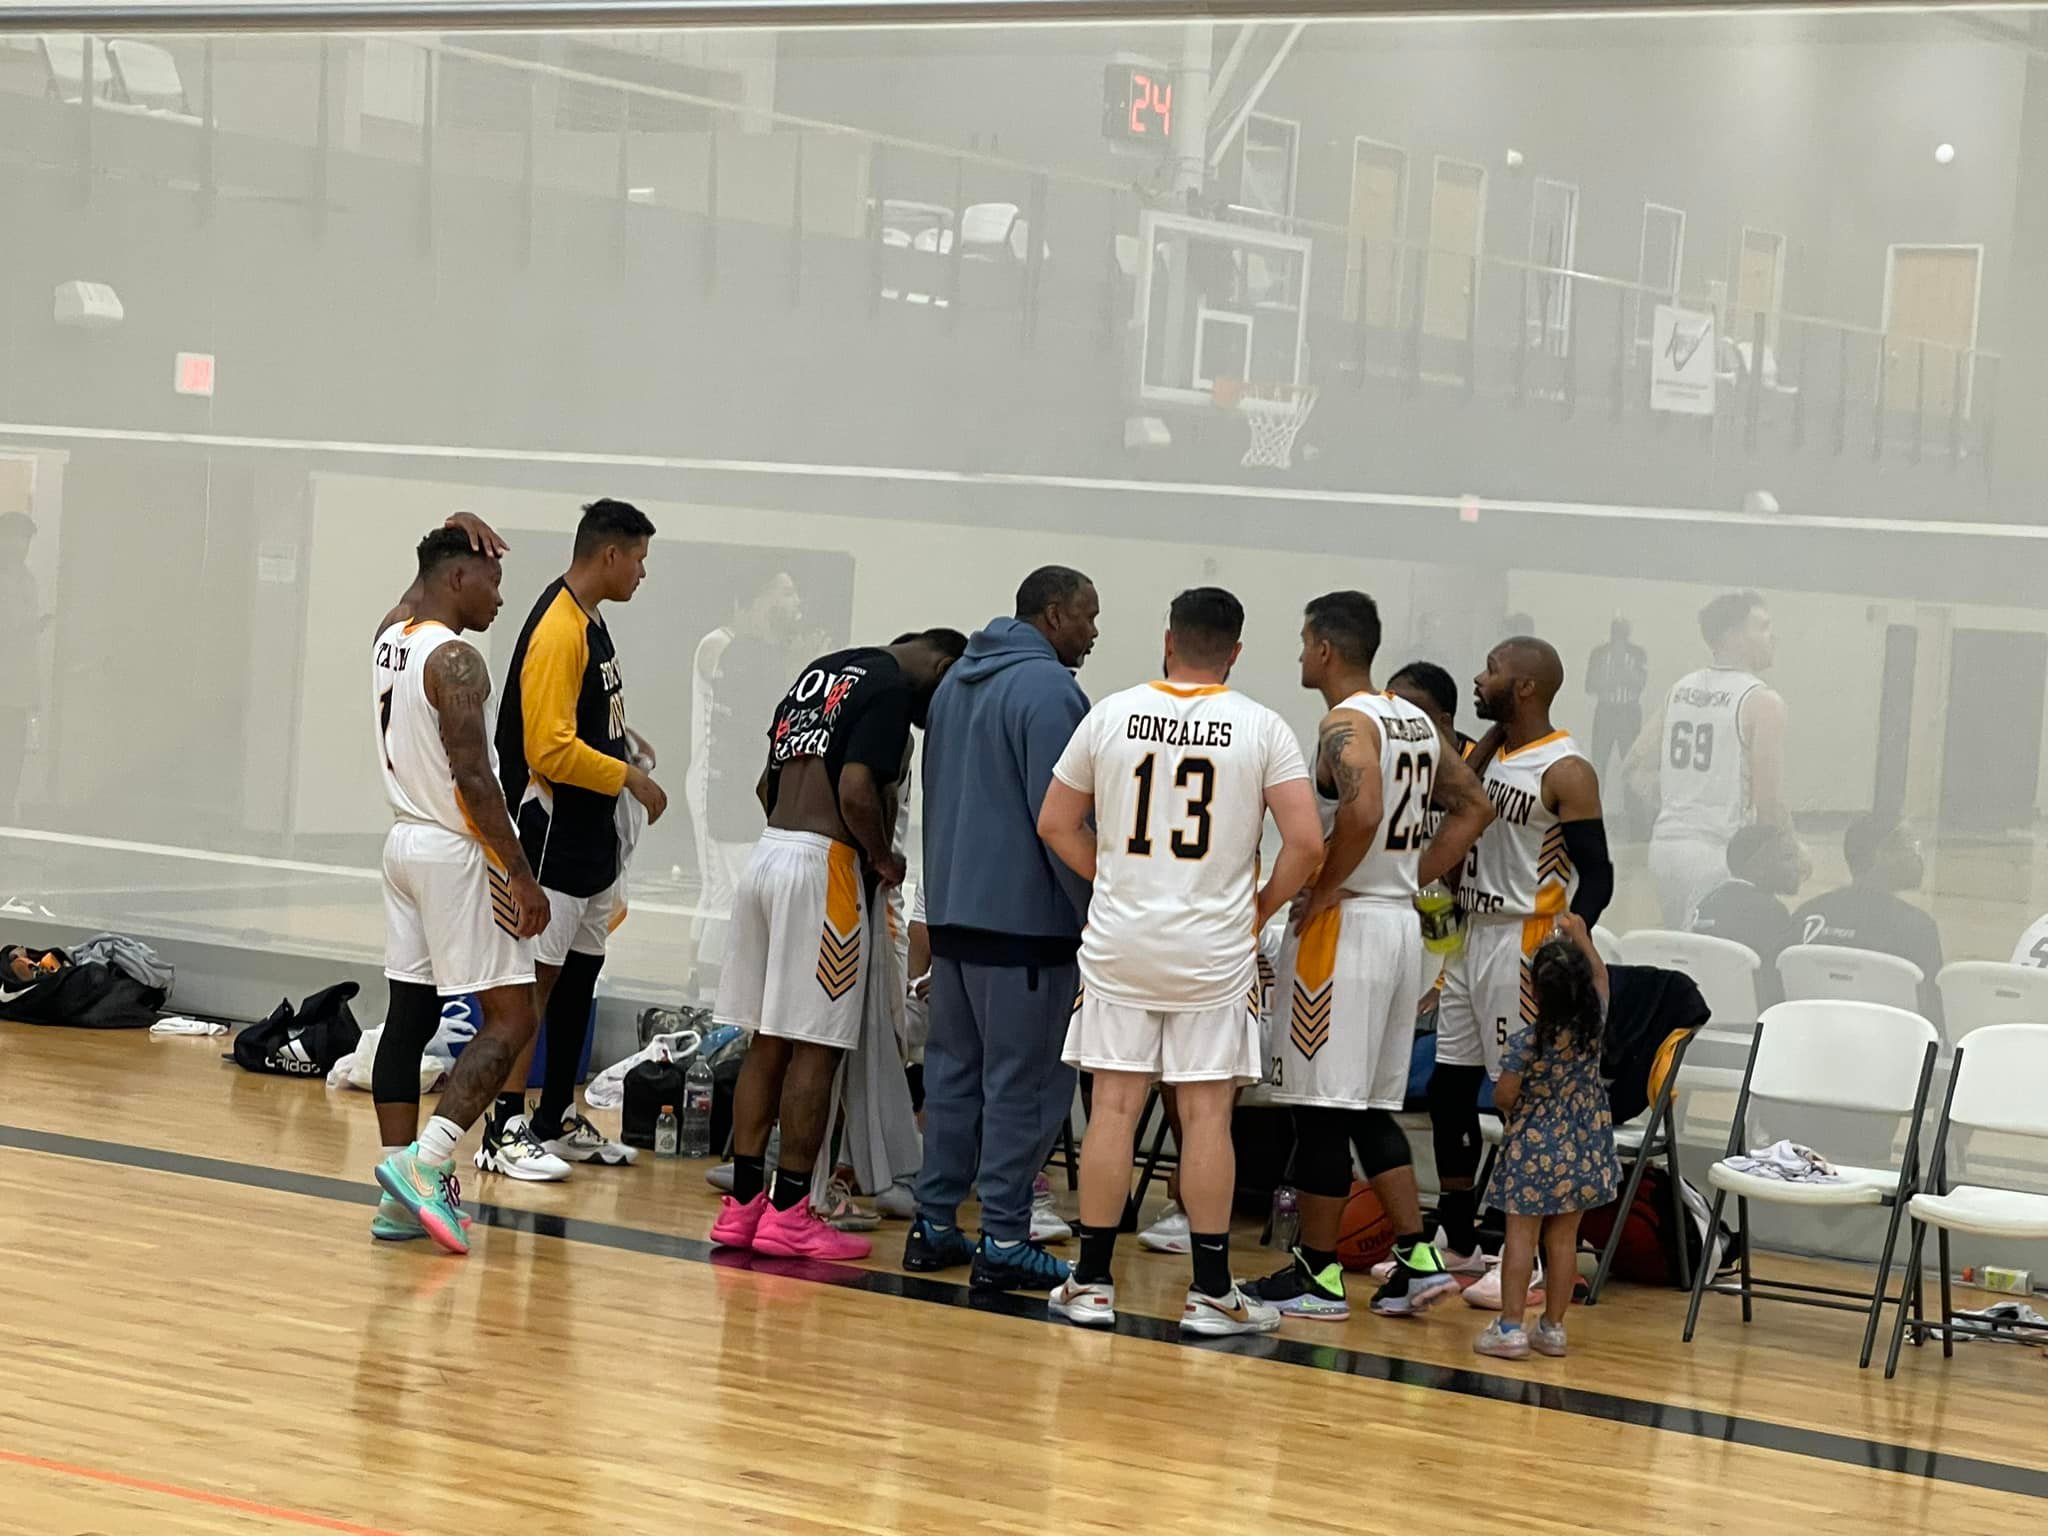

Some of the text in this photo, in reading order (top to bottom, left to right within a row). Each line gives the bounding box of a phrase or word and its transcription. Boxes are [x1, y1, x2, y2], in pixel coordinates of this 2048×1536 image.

[1131, 75, 1171, 135] 24
[1127, 714, 1232, 747] GONZALES
[1670, 721, 1714, 772] 69
[1126, 751, 1216, 860] 13
[1385, 751, 1433, 851] 23
[1496, 1017, 1507, 1046] 5
